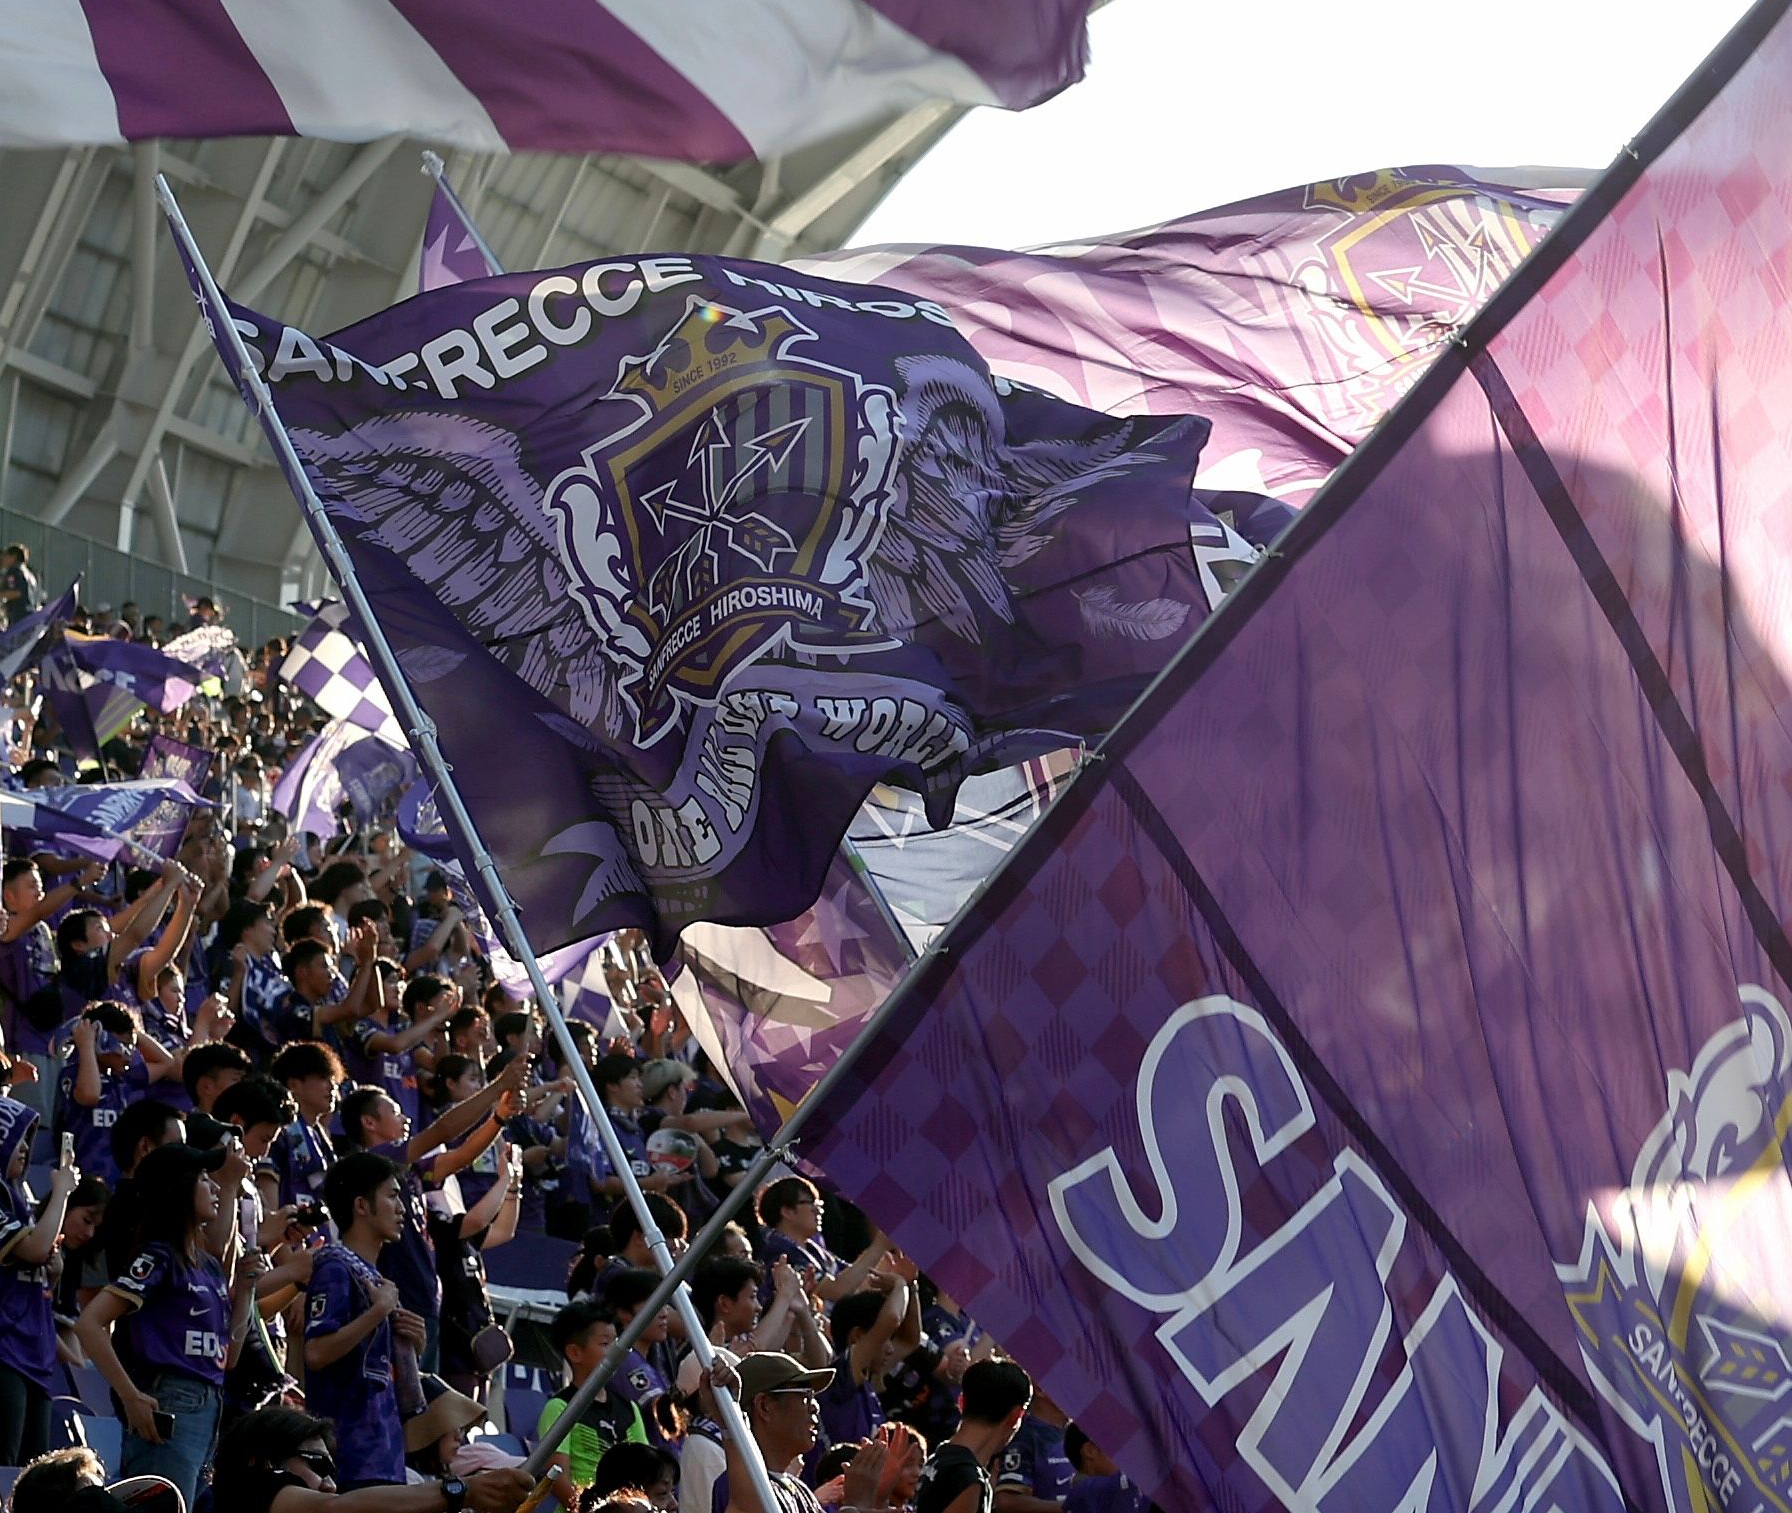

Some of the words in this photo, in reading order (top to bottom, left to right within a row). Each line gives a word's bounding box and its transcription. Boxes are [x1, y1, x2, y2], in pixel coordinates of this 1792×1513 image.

[673, 366, 705, 395] SINCE
[707, 352, 738, 374] 1992
[647, 616, 702, 691] SANFRECCE
[709, 586, 824, 627] HIROSHIMA
[631, 794, 723, 869] ONE
